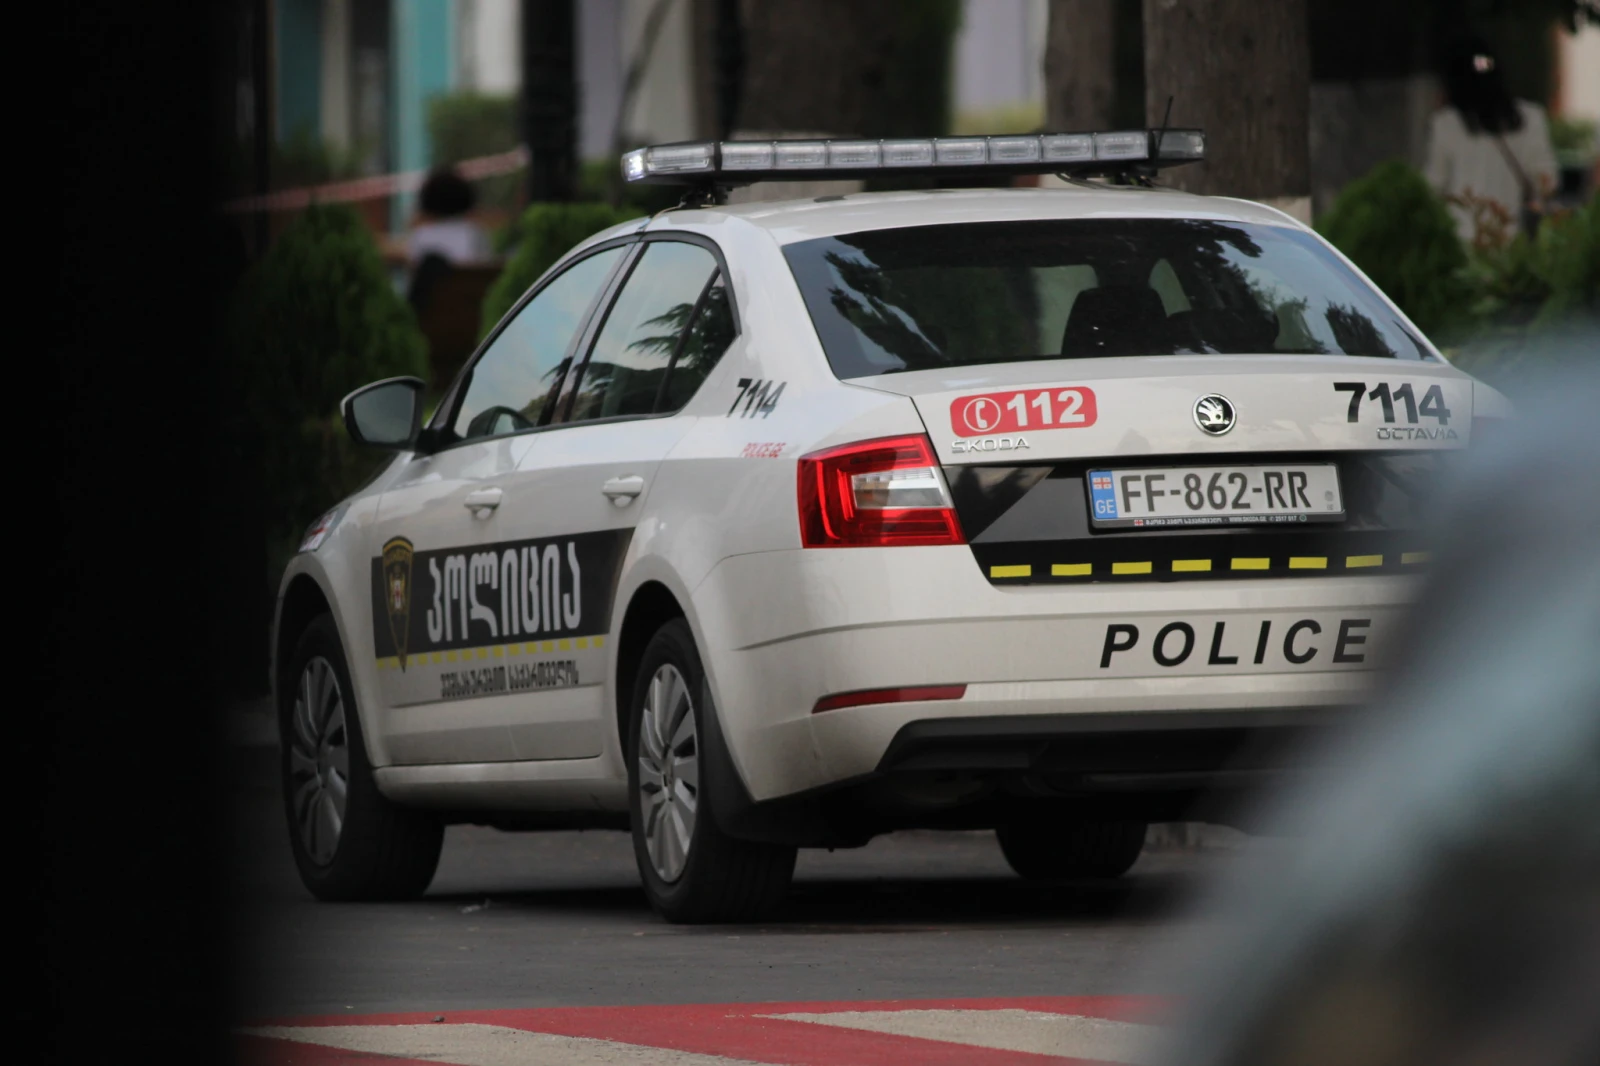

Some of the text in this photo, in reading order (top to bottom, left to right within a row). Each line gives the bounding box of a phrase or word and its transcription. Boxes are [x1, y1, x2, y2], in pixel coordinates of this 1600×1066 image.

[726, 377, 788, 420] 7114
[1006, 390, 1086, 427] 112
[1333, 382, 1451, 426] 7114
[1376, 427, 1459, 440] OCTAVIA
[1095, 499, 1116, 515] GE
[1120, 471, 1312, 513] FF-862-RR
[427, 541, 582, 644] პოლიცია
[1100, 618, 1372, 668] POLICE
